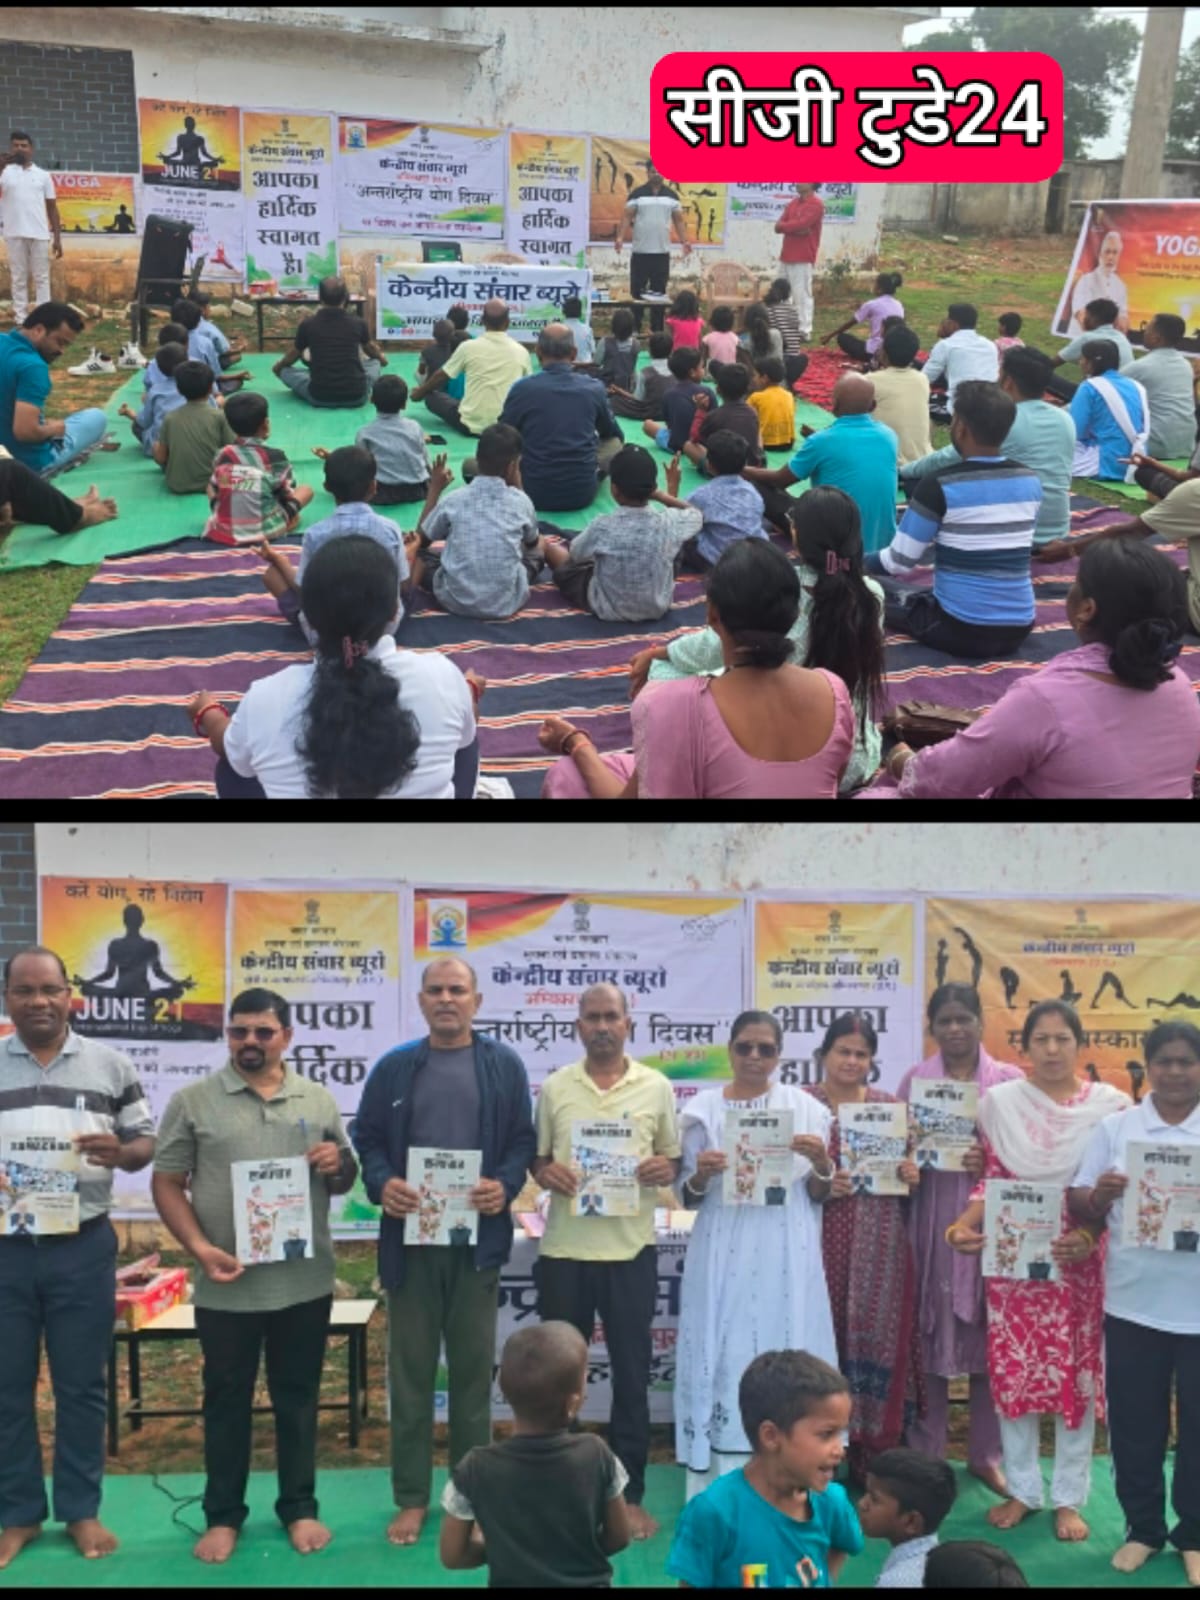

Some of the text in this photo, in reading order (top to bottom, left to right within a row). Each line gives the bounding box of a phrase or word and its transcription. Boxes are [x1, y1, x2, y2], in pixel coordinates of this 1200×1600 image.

[53, 174, 102, 188] YOGA
[161, 165, 219, 180] JUNE 21
[252, 170, 320, 189] आपका
[518, 186, 574, 203] आपका
[257, 194, 317, 219] हार्दिक
[522, 208, 570, 230] हार्दिक
[256, 229, 320, 246] स्वागत
[519, 239, 572, 255] स्वागत
[1156, 235, 1200, 256] YOG
[388, 274, 467, 301] केन्द्रीय
[473, 277, 531, 301] संचार
[302, 951, 345, 970] संचार
[492, 961, 667, 993] केन्द्रीय संचार ब्यूरो
[76, 996, 183, 1022] JUNE 21
[286, 1001, 375, 1030] पका
